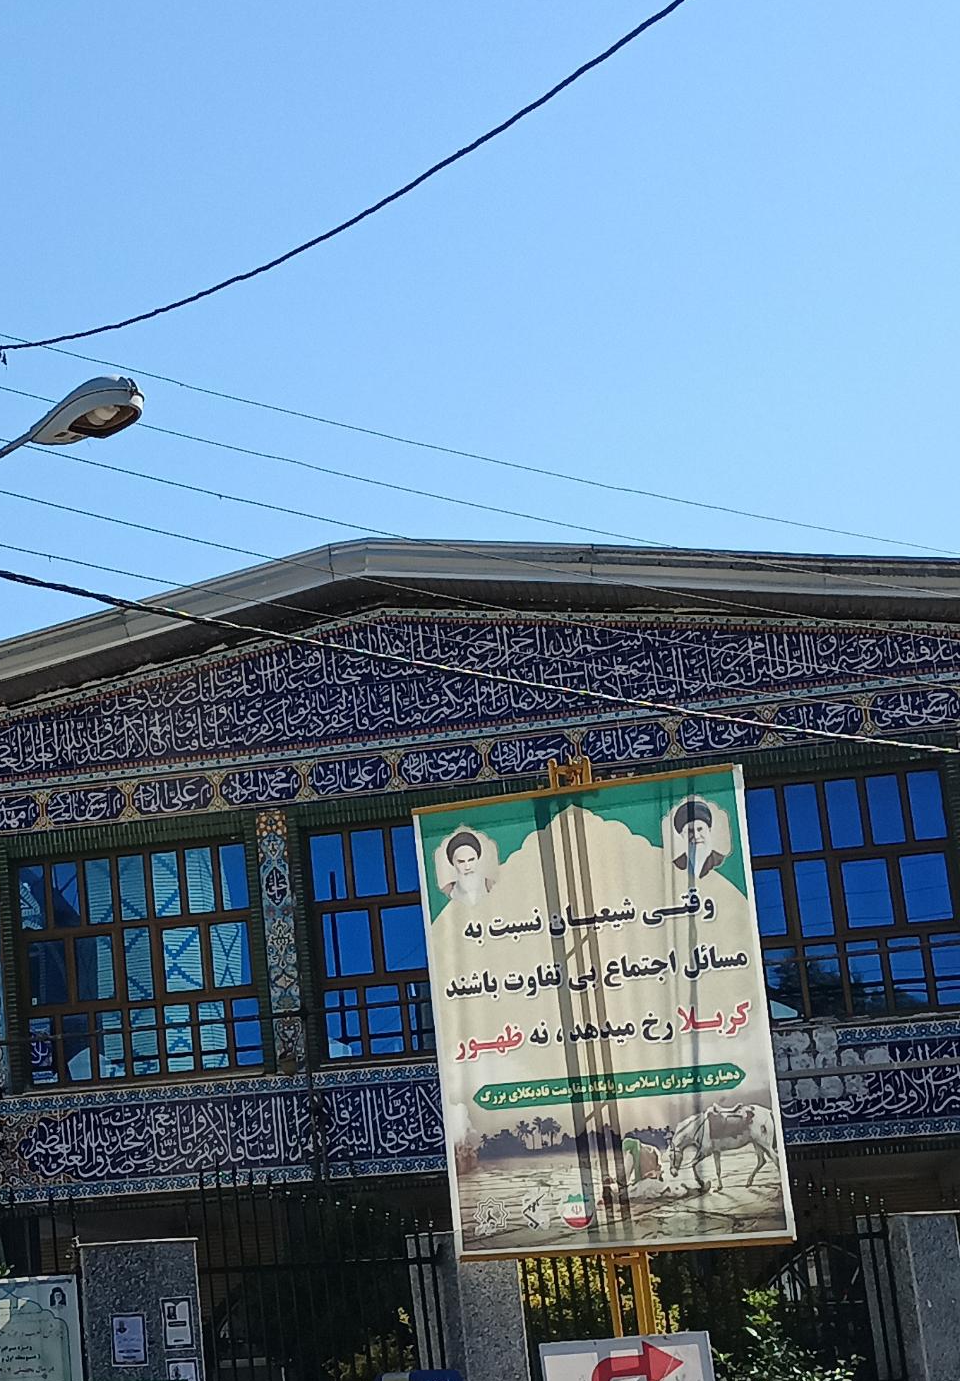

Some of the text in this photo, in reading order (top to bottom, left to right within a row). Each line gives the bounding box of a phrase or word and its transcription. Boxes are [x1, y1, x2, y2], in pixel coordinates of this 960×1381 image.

[464, 888, 715, 945] وقتی شیعیان نسبت به
[446, 945, 748, 999] مسائل اجتماع بی تفاوت باشند
[529, 1021, 549, 1044] نه
[643, 1011, 674, 1040] رخ
[677, 1002, 750, 1034] کربلا
[455, 1025, 523, 1061] ظهور
[625, 1076, 660, 1093] اسلامی
[661, 1072, 694, 1090] شورای
[479, 1089, 508, 1105] بزرگ
